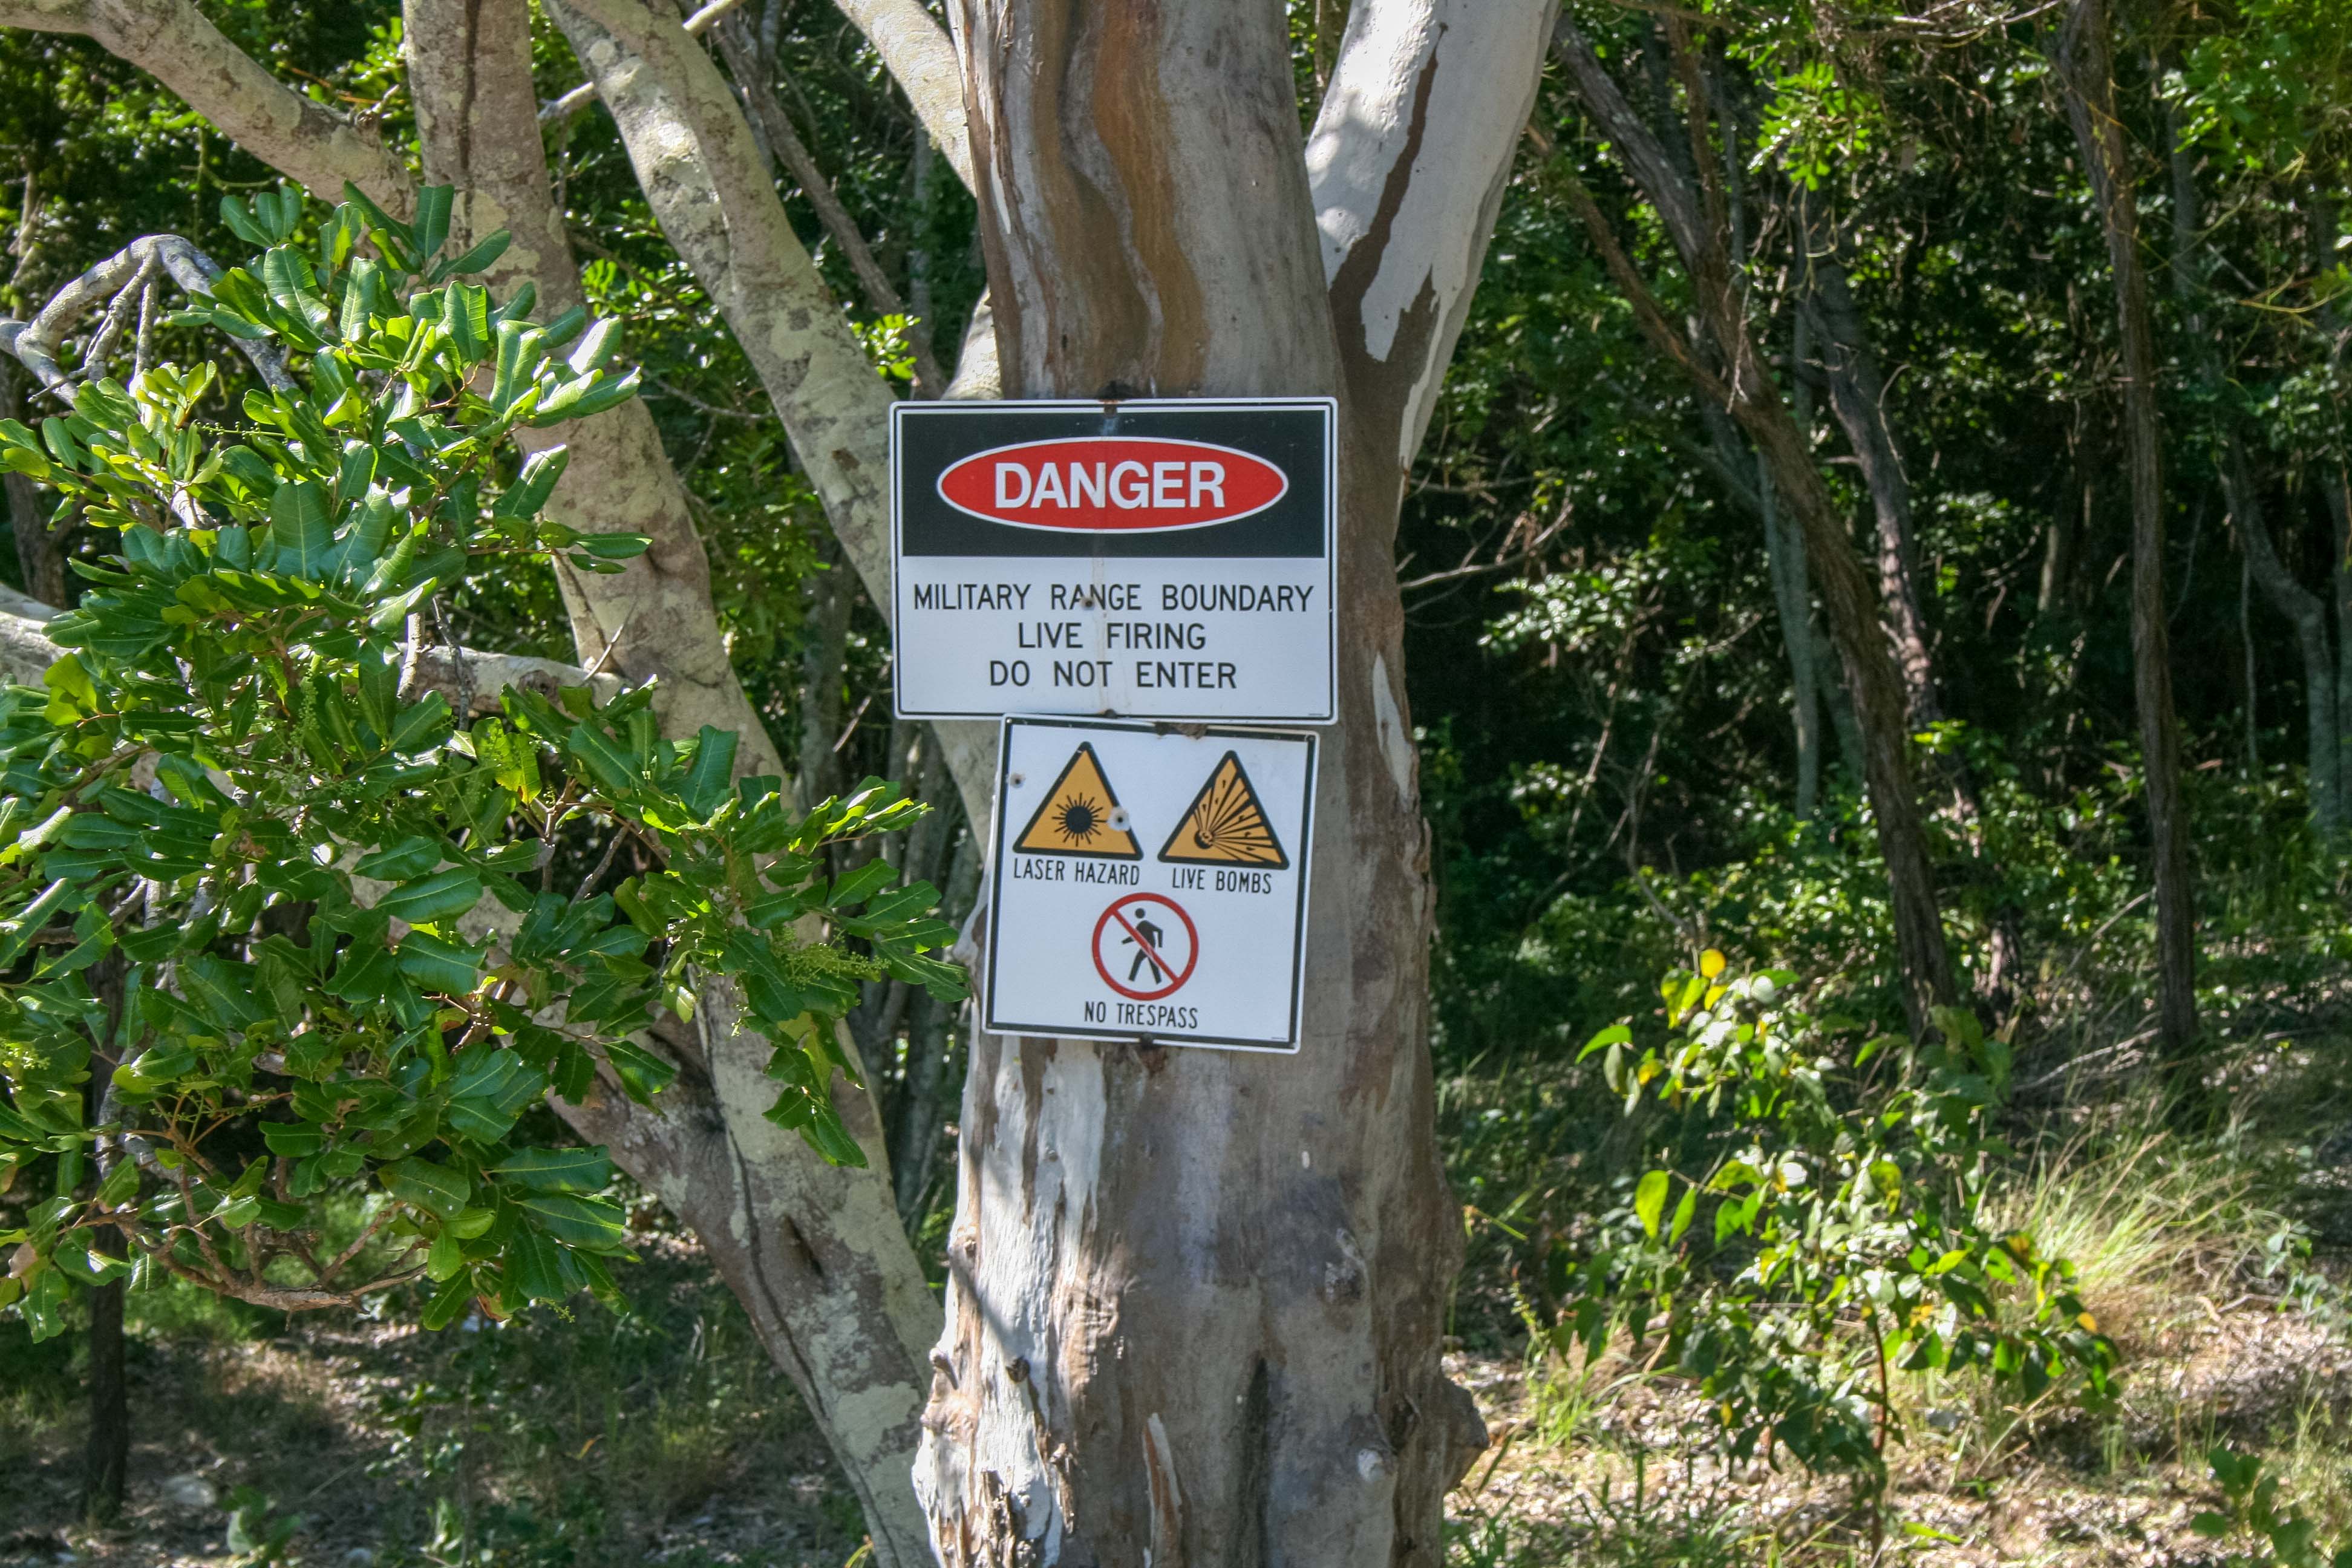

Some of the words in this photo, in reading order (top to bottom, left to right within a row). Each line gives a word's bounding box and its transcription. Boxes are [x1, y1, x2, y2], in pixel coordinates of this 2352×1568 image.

[995, 460, 1225, 509] DANGER
[913, 583, 1032, 610] MILITARY
[1050, 583, 1142, 611] RANGE
[1162, 584, 1315, 612] BOUNDARY
[1018, 622, 1084, 649] LIVE
[1106, 622, 1206, 650] FIRING
[989, 659, 1031, 687] DO
[1054, 660, 1114, 688] NOT
[1136, 661, 1237, 690] ENTER
[1013, 857, 1065, 881] LASER
[1074, 862, 1140, 886] HAZARD
[1172, 867, 1206, 890] LIVE
[1215, 871, 1272, 895] BOMBS
[1084, 1001, 1106, 1024] NO
[1117, 1002, 1198, 1030] TRESPASS
